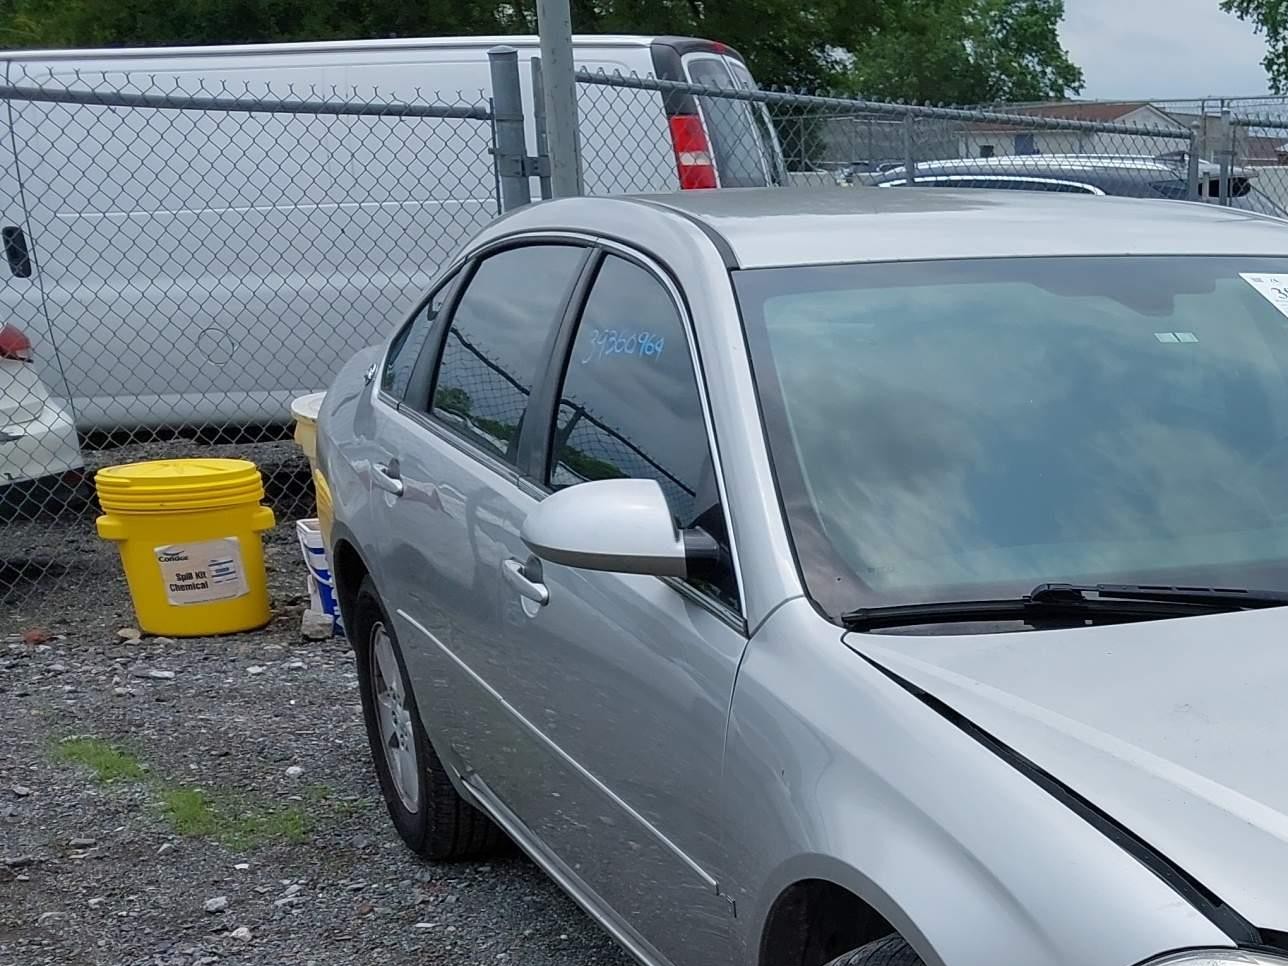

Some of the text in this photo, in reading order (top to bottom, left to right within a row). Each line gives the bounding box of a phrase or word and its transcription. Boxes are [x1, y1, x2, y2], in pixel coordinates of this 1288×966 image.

[175, 572, 194, 582] Spill
[195, 570, 208, 579] Kit
[169, 581, 209, 592] Chemical
